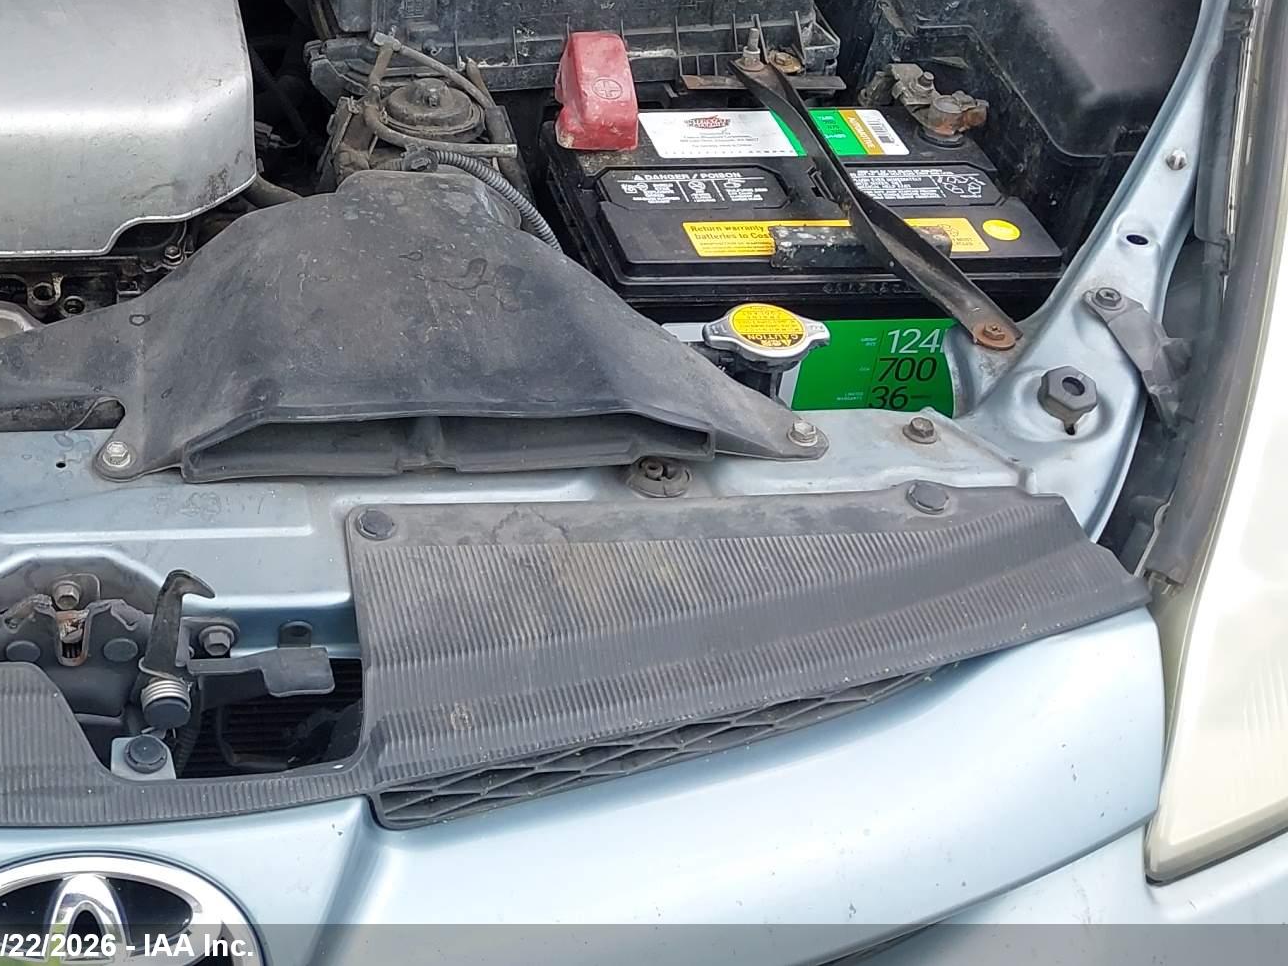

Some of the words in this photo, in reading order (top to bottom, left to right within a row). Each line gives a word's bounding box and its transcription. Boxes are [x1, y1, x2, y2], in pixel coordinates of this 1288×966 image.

[848, 116, 876, 149] AUTOMOTIVE
[695, 232, 737, 240] batteries
[724, 225, 764, 233] warranty
[887, 328, 948, 354] 124
[877, 357, 937, 382] 700
[869, 385, 908, 410] 36
